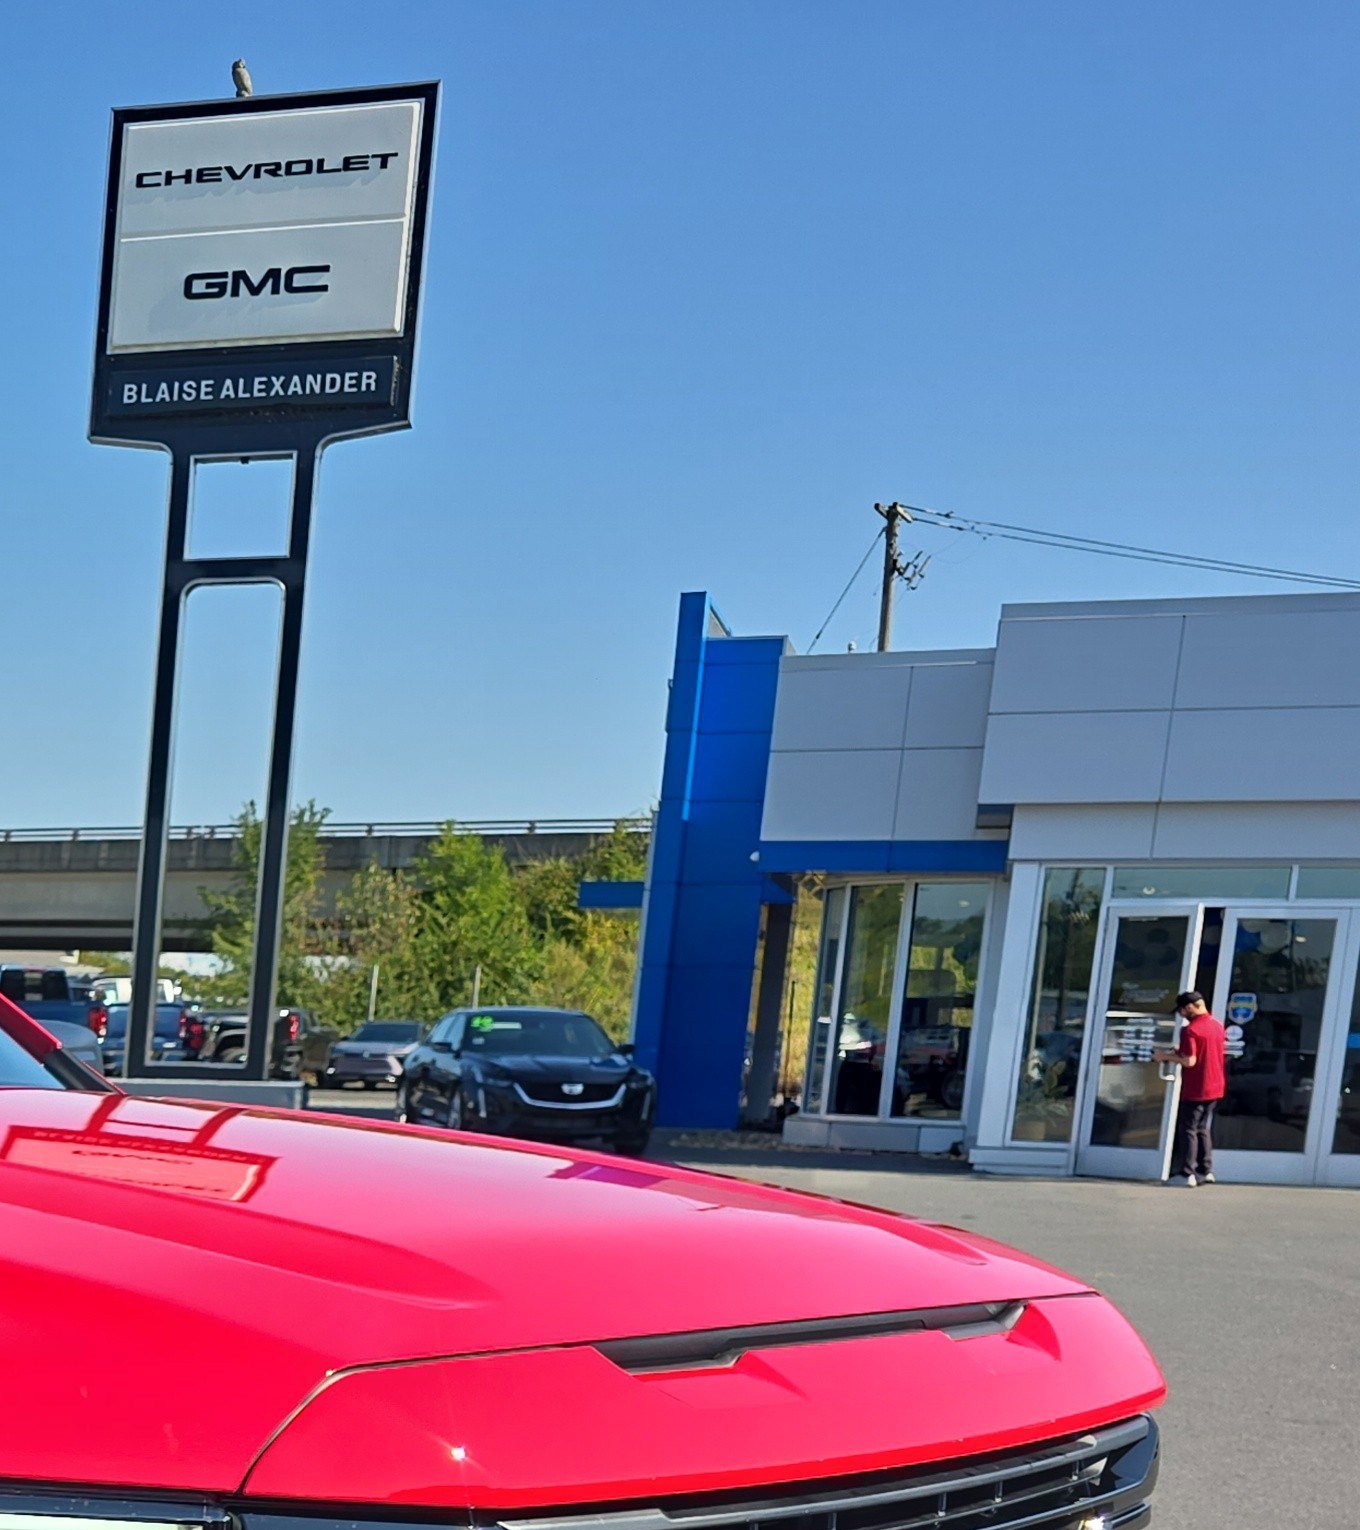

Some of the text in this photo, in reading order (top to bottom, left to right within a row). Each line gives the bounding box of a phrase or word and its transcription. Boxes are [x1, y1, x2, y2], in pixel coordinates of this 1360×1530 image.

[135, 152, 399, 189] CHEVROLET
[183, 264, 331, 300] GMC
[122, 370, 378, 404] BLAISE ALEXANDER
